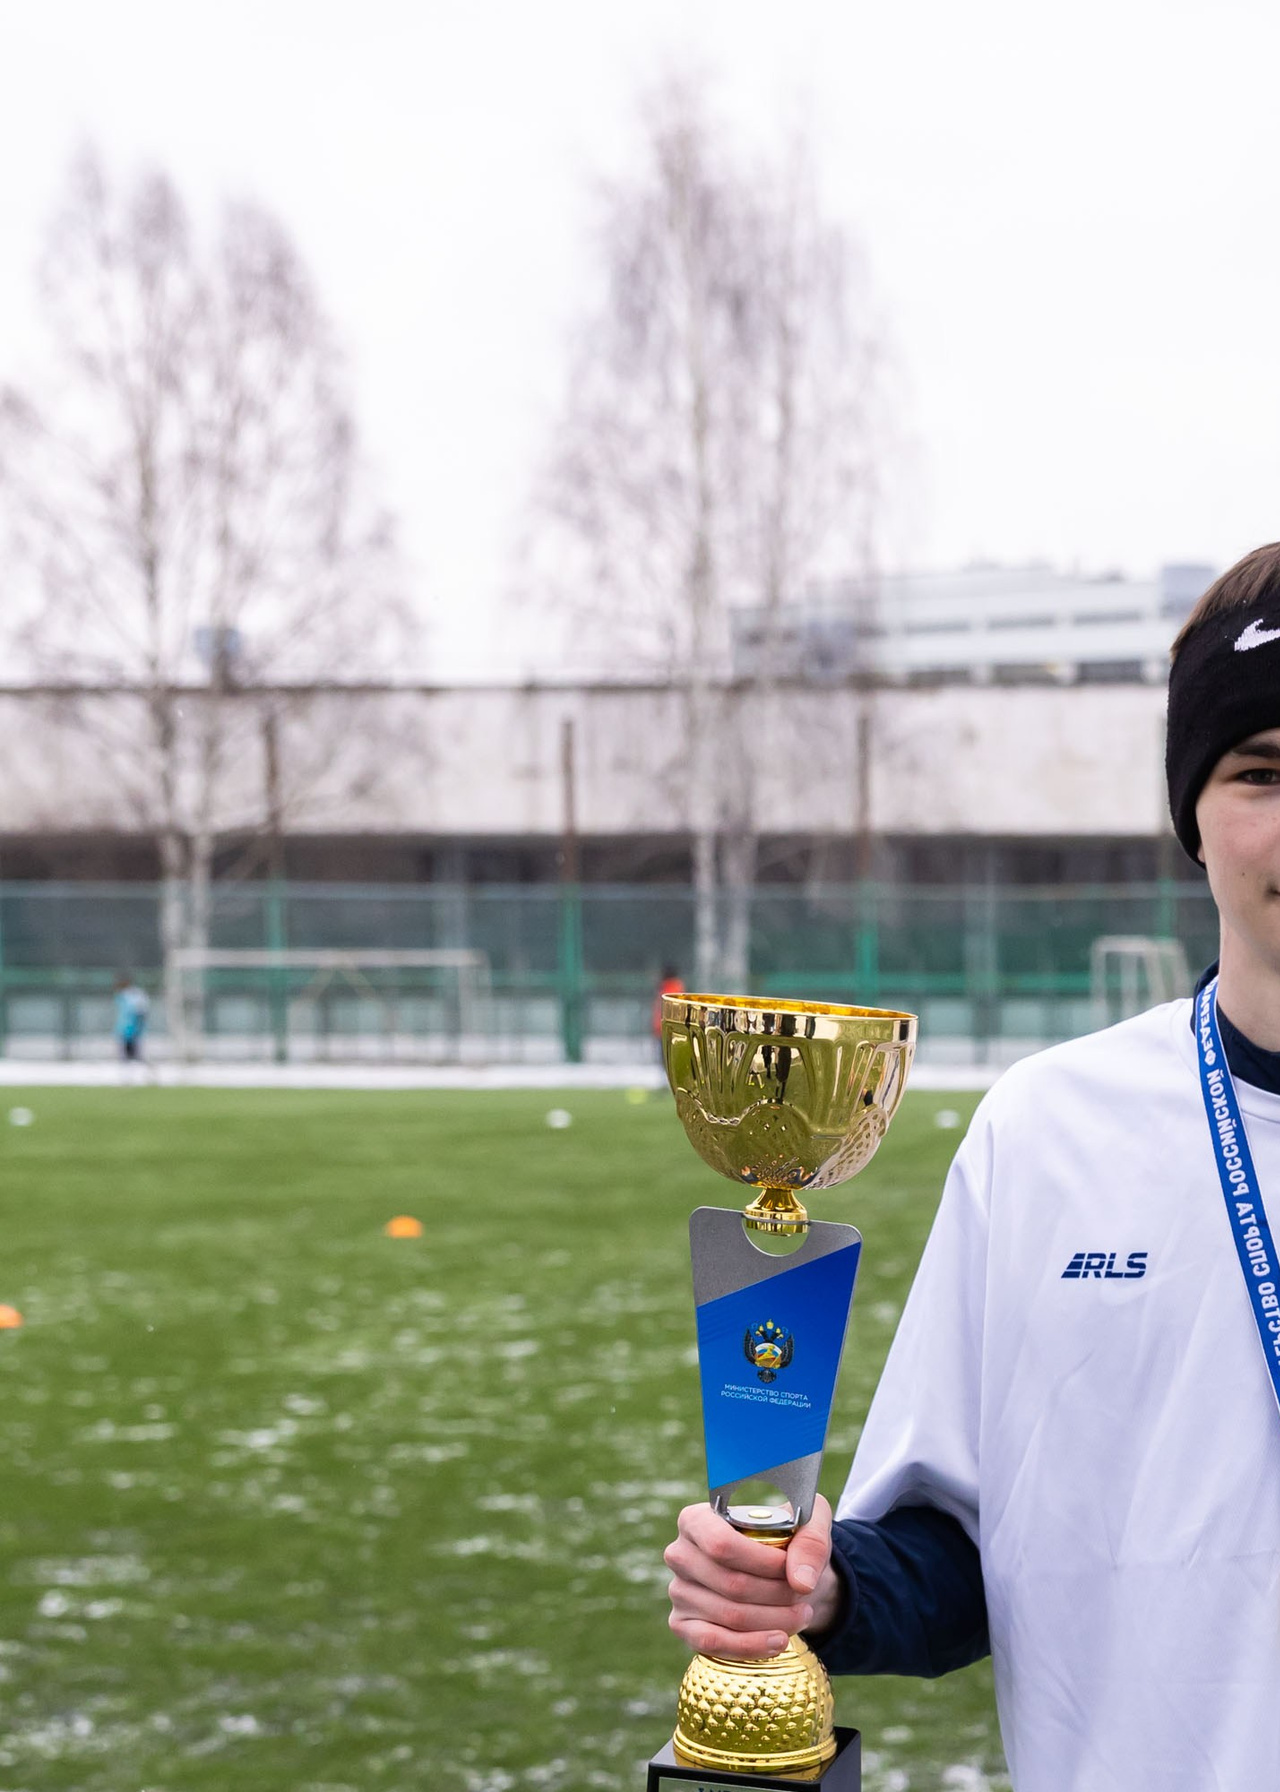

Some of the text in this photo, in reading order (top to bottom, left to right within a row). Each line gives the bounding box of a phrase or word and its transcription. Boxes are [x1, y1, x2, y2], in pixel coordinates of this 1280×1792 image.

[721, 1390, 811, 1408] РОССИЙСКОЙ ФЕДЕРАЦИИ
[724, 1384, 808, 1400] МИНИСТЕРСТВО СПОРТА
